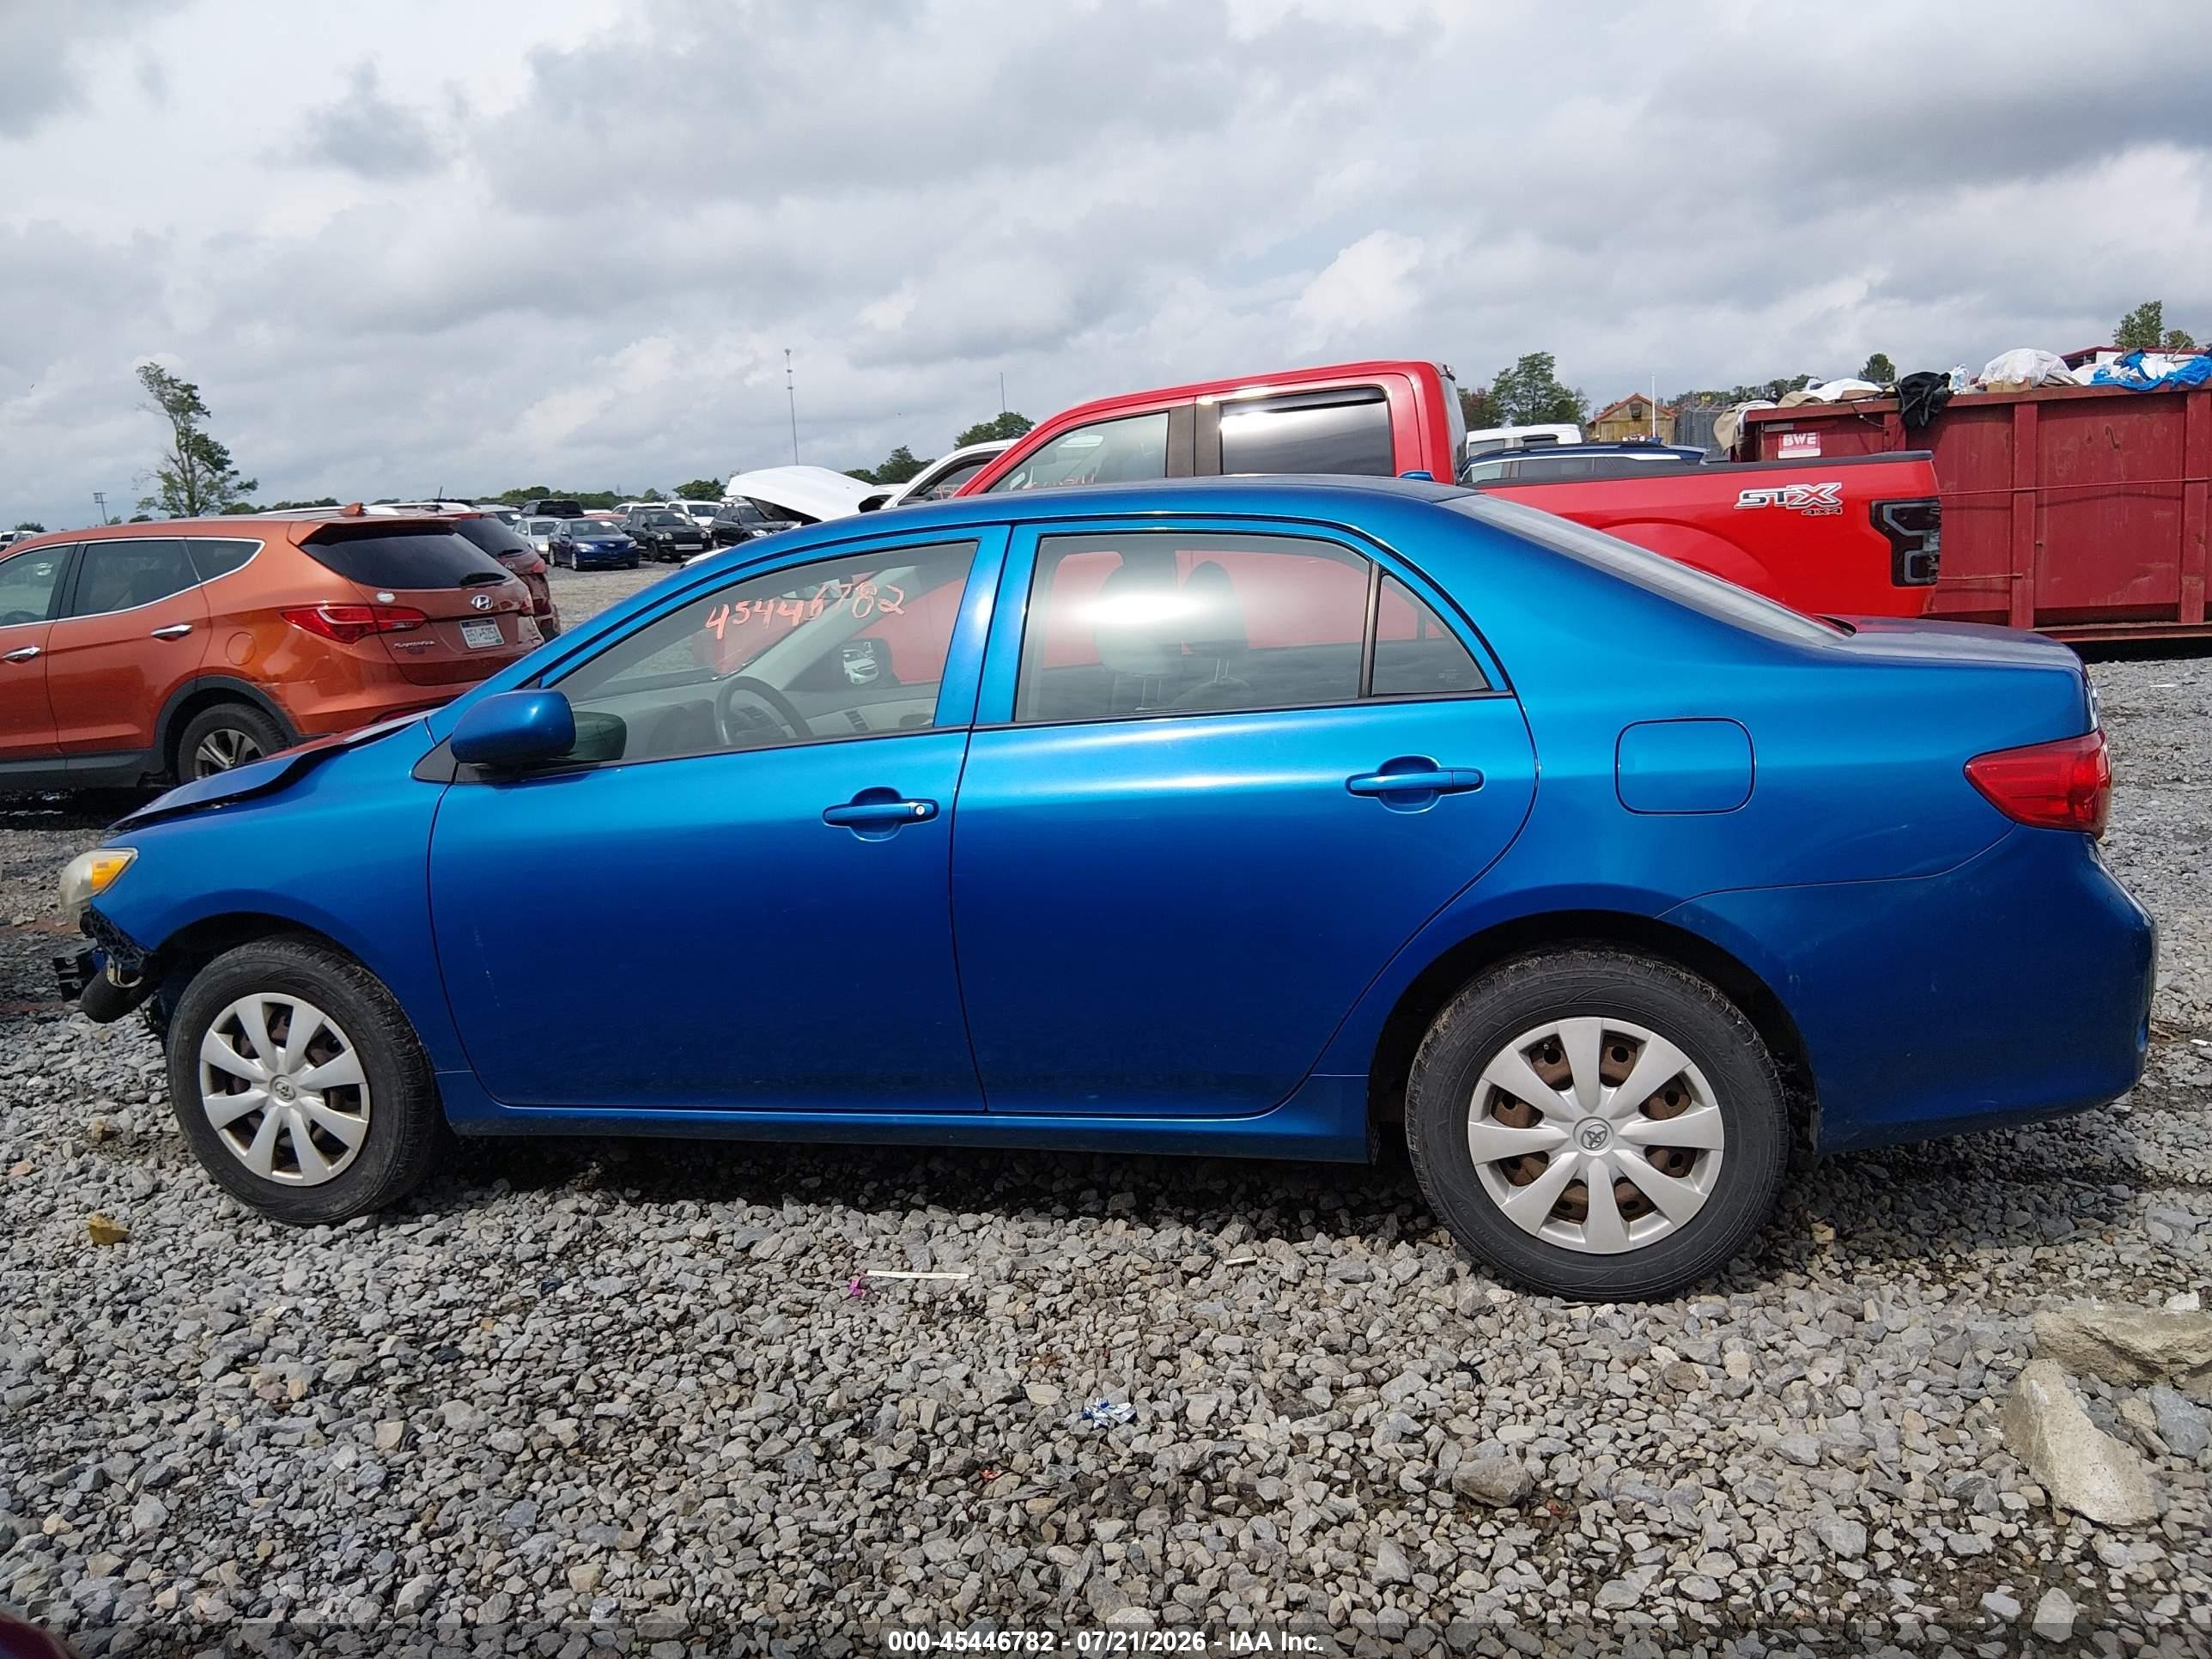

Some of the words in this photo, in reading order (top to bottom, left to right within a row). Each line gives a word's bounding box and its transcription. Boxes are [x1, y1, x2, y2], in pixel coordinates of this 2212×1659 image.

[1783, 432, 1817, 447] BWE
[1735, 483, 1843, 509] STX
[705, 580, 905, 639] 45446782
